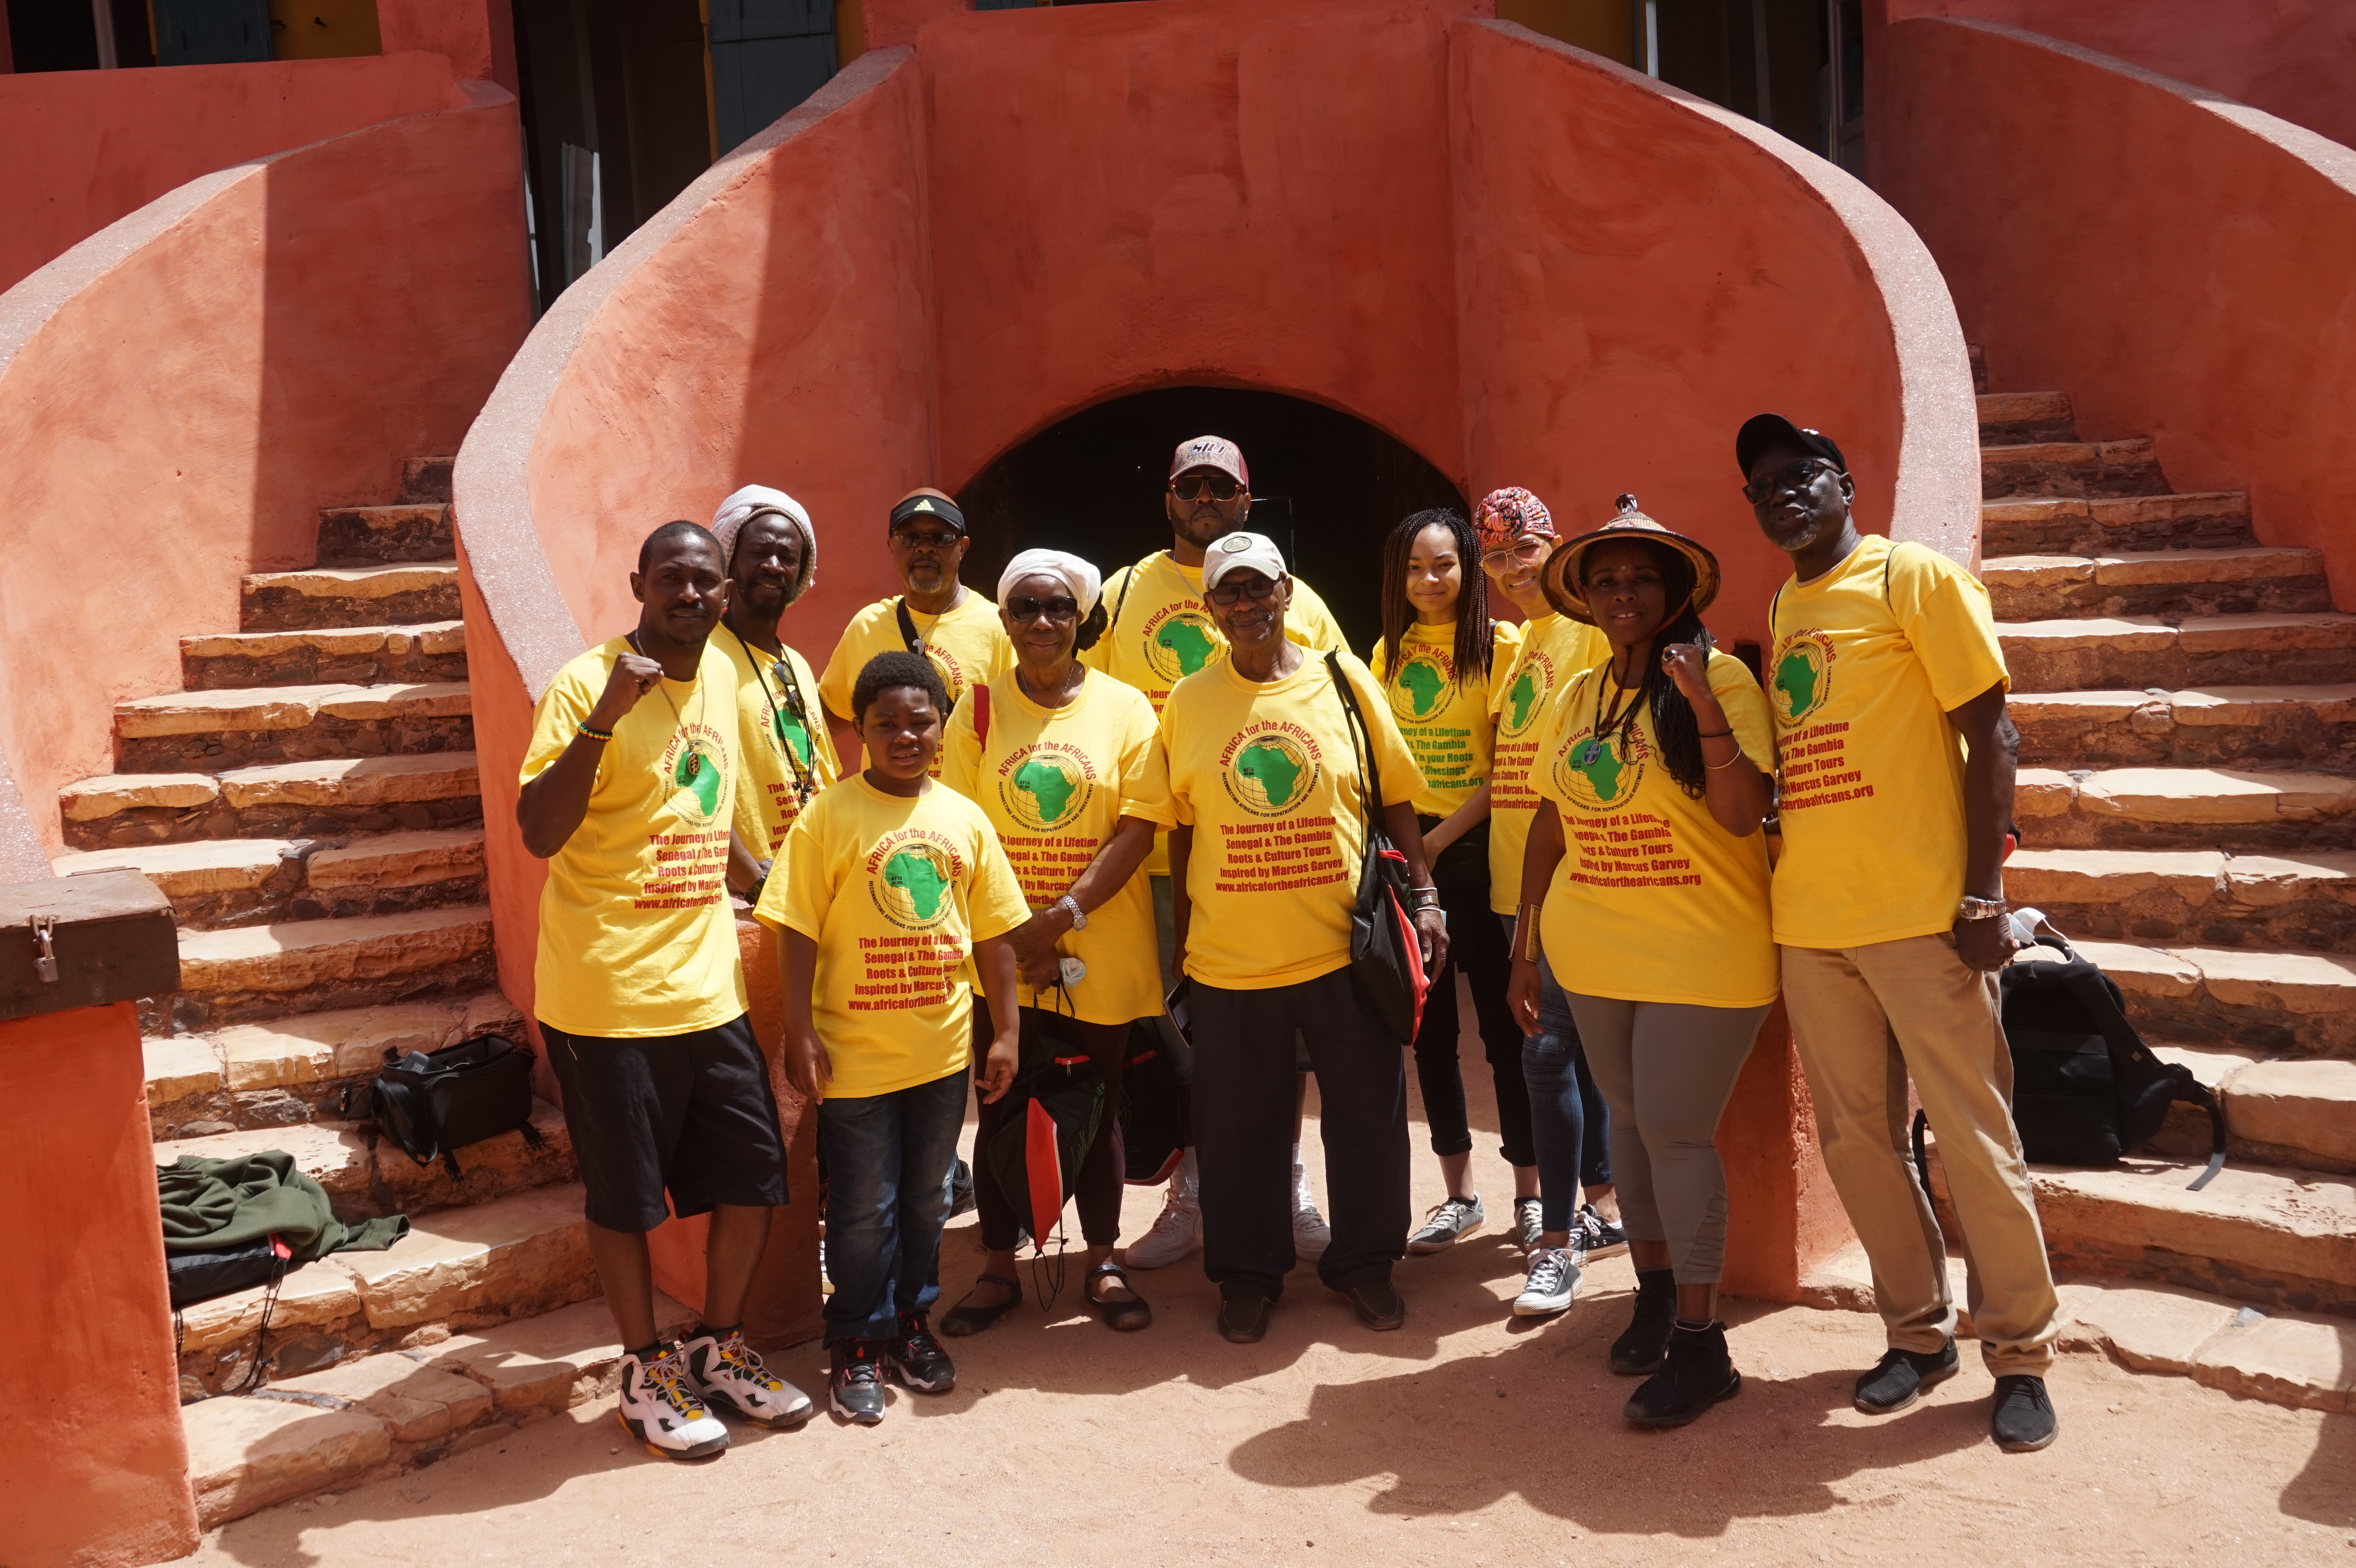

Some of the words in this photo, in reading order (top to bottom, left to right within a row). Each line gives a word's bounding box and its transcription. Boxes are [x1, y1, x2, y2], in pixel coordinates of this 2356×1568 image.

[1189, 442, 1226, 456] SIU
[1225, 541, 1250, 549] ALASKA
[1143, 607, 1170, 637] AFRICA
[1169, 602, 1182, 612] for
[1184, 599, 1199, 609] the
[1419, 644, 1431, 653] the
[1794, 629, 1808, 639] the
[1805, 628, 1836, 663] AFRICANS
[934, 647, 963, 686] AFRICANS
[1143, 641, 1155, 670] RECONNECTING
[1154, 670, 1172, 683] AFRICANS
[1529, 650, 1538, 659] the
[1536, 652, 1554, 689] AFRICANS
[1823, 666, 1832, 702] INVESTMENTS
[1533, 692, 1548, 720] INVESTMENTS
[1392, 710, 1406, 721] AFRICANS
[1415, 714, 1438, 724] REPATRIATION
[1419, 727, 1427, 736] of
[1435, 727, 1471, 737] Lifetime
[1794, 730, 1802, 742] of
[1803, 730, 1808, 740] a
[1810, 721, 1849, 738] Lifetime
[664, 736, 680, 775] AFRICA
[690, 722, 701, 733] the
[703, 725, 728, 769] AFRICANS
[1219, 732, 1247, 767] AFRICA
[1245, 724, 1259, 736] for
[1261, 720, 1277, 731] the
[1279, 721, 1322, 760] AFRICANS
[1416, 740, 1431, 749] The
[1432, 740, 1466, 749] Gambia
[1558, 727, 1591, 757] AFRICA
[1791, 746, 1805, 759] The
[1807, 739, 1844, 756] Gambia
[998, 748, 1028, 777] AFRICA
[1028, 743, 1041, 753] for
[1044, 741, 1059, 750] the
[1060, 743, 1096, 780] AFRICANS
[1427, 755, 1445, 764] your
[1447, 753, 1473, 762] Roots
[1507, 756, 1516, 766] The
[1786, 762, 1813, 778] Culture
[1814, 756, 1845, 771] Tours
[1501, 771, 1519, 780] Culture
[1790, 778, 1821, 794] Marcus
[1823, 770, 1862, 787] Garvey
[767, 782, 785, 794] The
[1222, 772, 1239, 804] RECONNECTING
[1238, 803, 1259, 816] AFRICANS
[1271, 801, 1302, 817] REPATRIATION
[1301, 793, 1309, 803] AND
[1308, 763, 1320, 794] INVESTMENTS
[1502, 784, 1523, 794] Marcus
[1553, 762, 1566, 797] RECONNECTING
[1567, 796, 1590, 810] AFRICANS
[1603, 798, 1630, 812] REPATRIATION
[1632, 763, 1645, 793] INVESTMENTS
[998, 782, 1012, 815] RECONNECTING
[1011, 815, 1030, 829] AFRICANS
[1041, 820, 1071, 833] REPATRIATION
[1071, 813, 1079, 822] AND
[1078, 784, 1093, 814] INVESTMENTS
[677, 811, 694, 826] AFRICANS
[1220, 825, 1234, 835] The
[1236, 822, 1274, 835] Journey
[1276, 820, 1286, 831] of
[1289, 820, 1295, 830] a
[1296, 816, 1336, 828] Lifetime
[1610, 815, 1621, 826] of
[1622, 816, 1629, 825] a
[649, 835, 669, 845] The
[671, 833, 705, 845] Journey
[709, 832, 713, 841] a
[1007, 835, 1043, 847] Journey
[1045, 837, 1054, 847] of
[1056, 838, 1062, 847] a
[1064, 836, 1098, 848] Lifetime
[1226, 838, 1262, 850] Senegal
[1265, 838, 1272, 847] &
[1273, 835, 1292, 846] The
[1294, 831, 1332, 844] Gambia
[1607, 831, 1628, 843] The
[1630, 827, 1672, 841] Gambia
[656, 848, 696, 861] Senegal
[866, 837, 895, 875] AFRICA
[893, 831, 908, 842] for
[909, 828, 925, 838] the
[928, 831, 962, 877] AFRICANS
[1032, 852, 1039, 861] &
[1041, 851, 1058, 862] The
[1060, 852, 1092, 862] Gambia
[1228, 854, 1253, 864] Roots
[1255, 854, 1262, 863] &
[1264, 849, 1301, 862] Culture
[1303, 846, 1331, 858] Tours
[1599, 846, 1606, 856] &
[1606, 845, 1639, 857] Culture
[1641, 844, 1673, 856] Tours
[657, 866, 686, 877] Roots
[688, 866, 692, 876] &
[694, 863, 718, 875] Culture
[1023, 866, 1030, 875] &
[1031, 866, 1065, 876] Culture
[1220, 867, 1256, 879] Inspired
[1258, 867, 1270, 878] by
[1272, 863, 1309, 876] Marcus
[1311, 858, 1343, 872] Garvey
[1601, 860, 1612, 873] by
[1615, 861, 1649, 872] Marcus
[1651, 859, 1690, 871] Garvey
[644, 881, 686, 894] Inspired
[688, 880, 696, 892] by
[698, 879, 721, 891] Marcus
[1025, 880, 1036, 891] by
[1037, 880, 1071, 891] Marcus
[1216, 870, 1349, 892] www.africafortheafricans.org
[869, 881, 884, 915] RECONNECTING
[884, 914, 905, 929] AFRICANS
[918, 917, 944, 931] REPATRIATION
[858, 938, 877, 948] The
[879, 936, 920, 947] Journey
[922, 935, 932, 945] of
[934, 936, 938, 945] a
[864, 952, 906, 964] Senegal
[909, 952, 915, 961] &
[917, 950, 935, 961] The
[938, 949, 963, 961] Gambia
[866, 968, 896, 979] Roots
[899, 969, 906, 977] &
[908, 965, 942, 977] Culture
[855, 983, 898, 996] Inspired
[900, 983, 912, 995] by
[914, 980, 945, 992] Marcus
